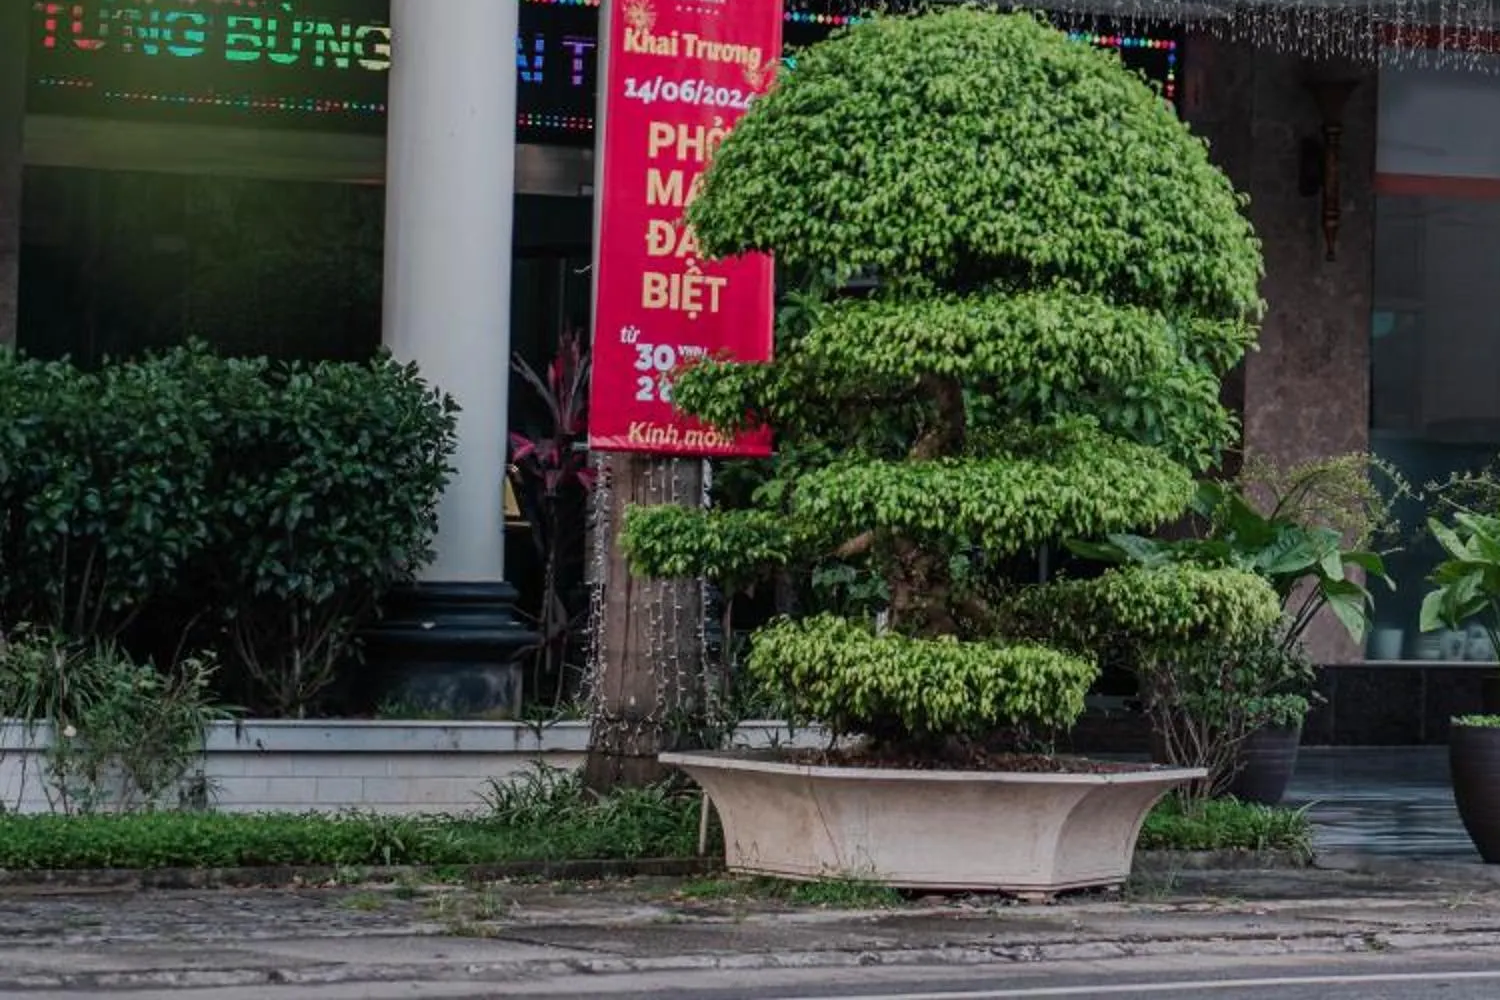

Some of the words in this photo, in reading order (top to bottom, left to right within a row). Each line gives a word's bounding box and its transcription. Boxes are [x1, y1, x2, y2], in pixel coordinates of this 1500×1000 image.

[623, 27, 679, 57] Khai
[641, 265, 728, 320] BIỆT
[634, 343, 675, 372] 30
[635, 375, 655, 401] 2
